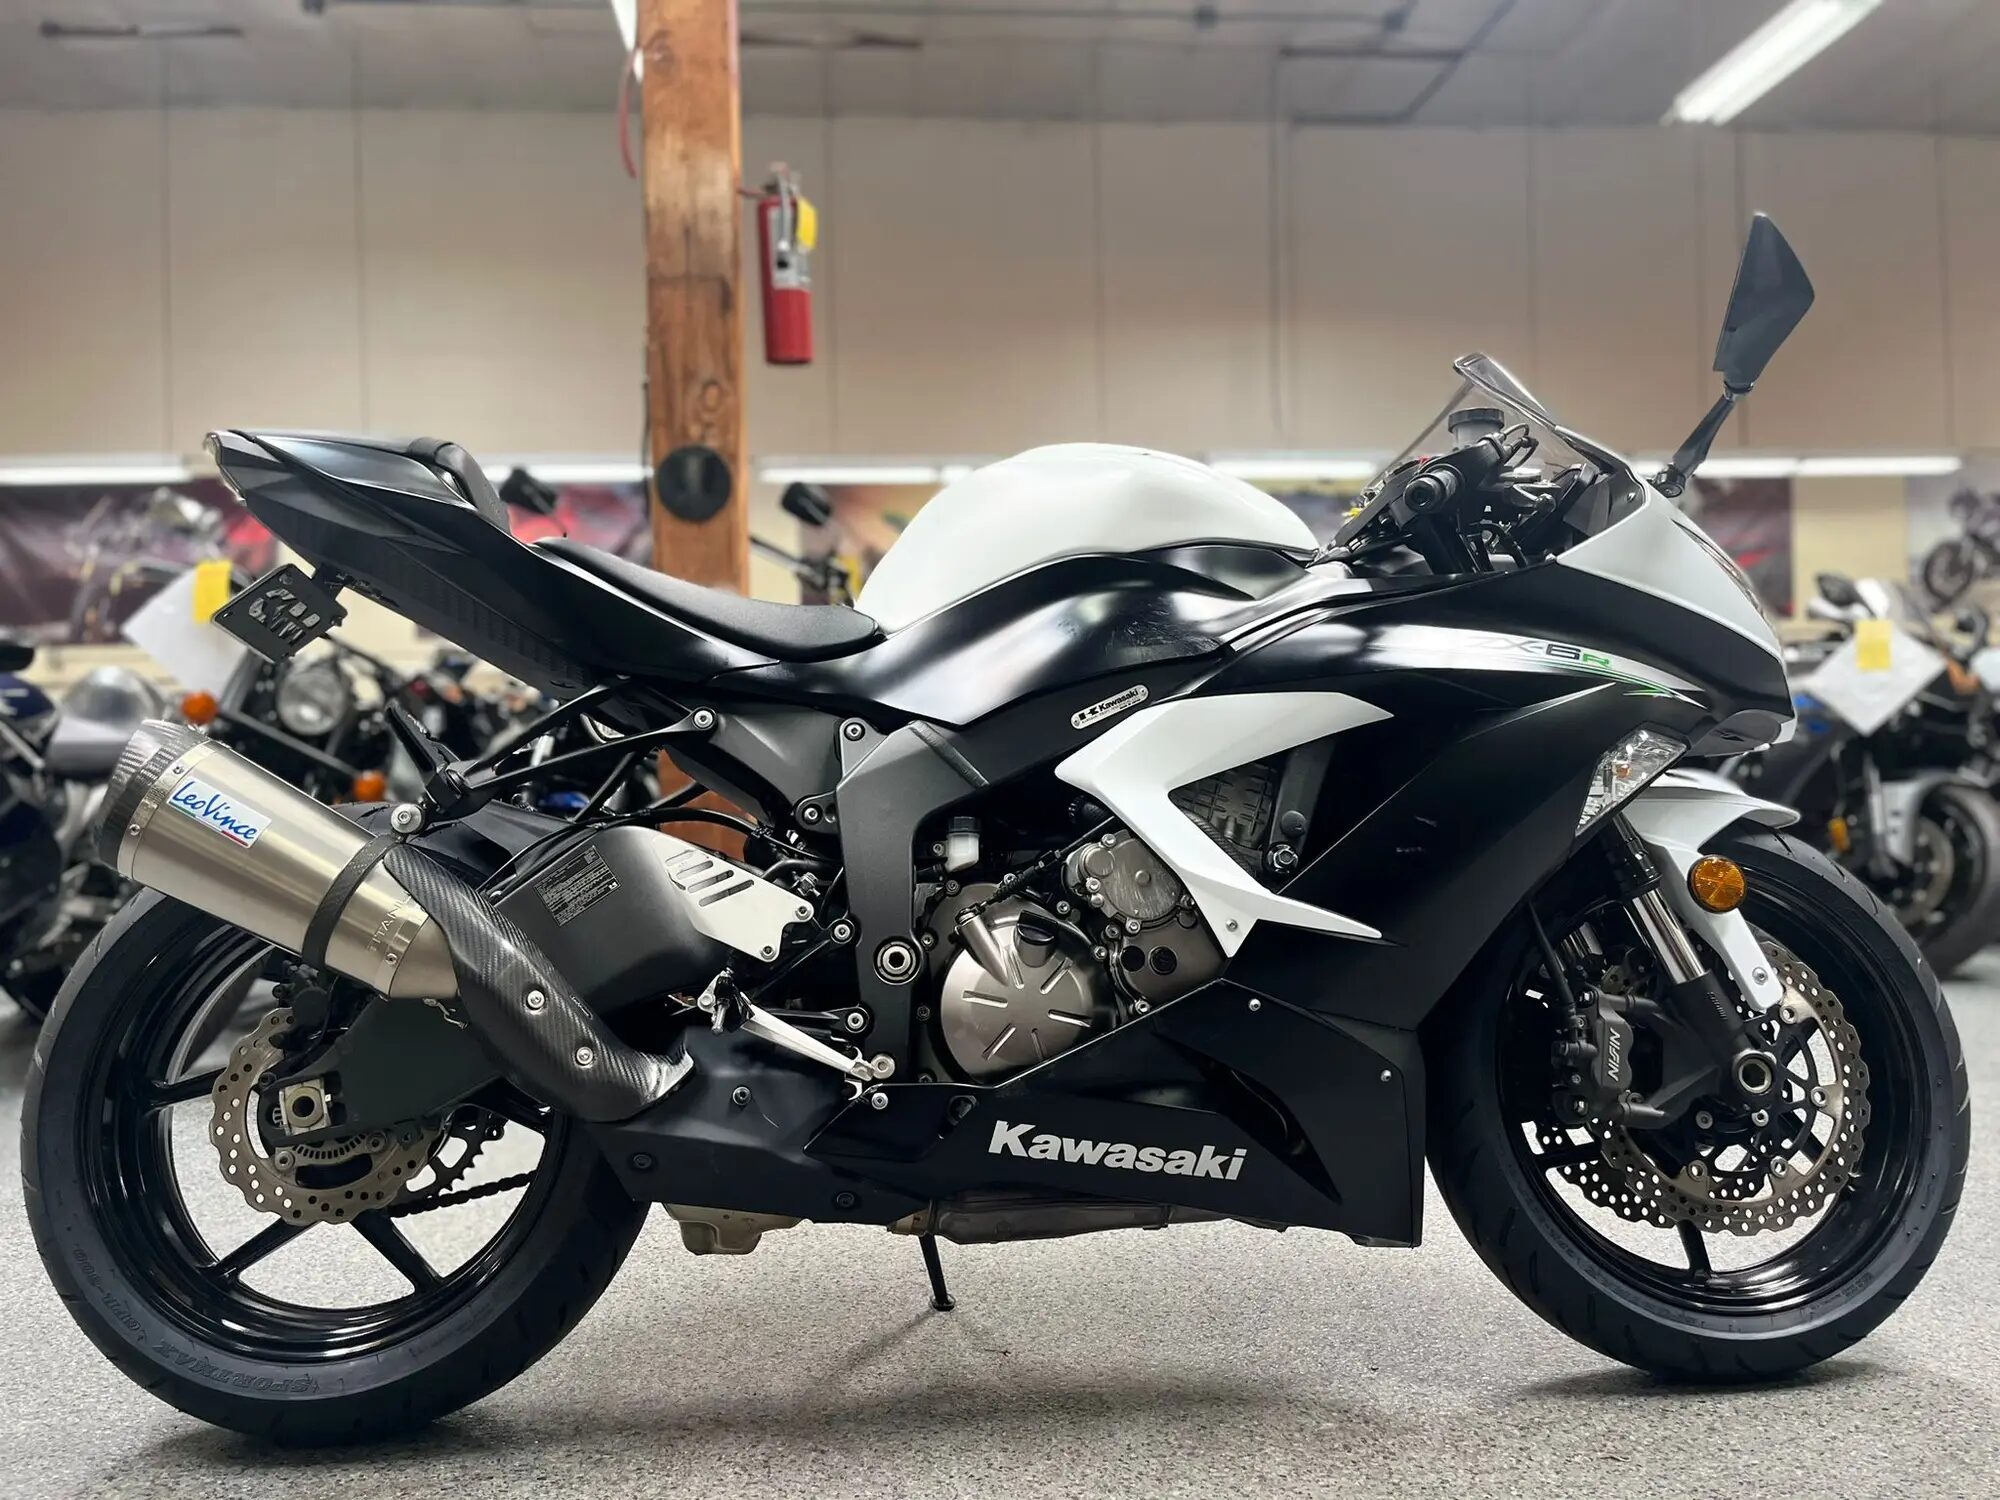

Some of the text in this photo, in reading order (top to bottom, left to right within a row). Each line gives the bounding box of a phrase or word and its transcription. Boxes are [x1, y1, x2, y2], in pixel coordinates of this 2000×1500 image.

[1467, 637, 1610, 668] ZX-6R
[1098, 689, 1139, 712] Kawasaki
[172, 780, 259, 841] LeoVince
[988, 1120, 1247, 1180] Kawasaki
